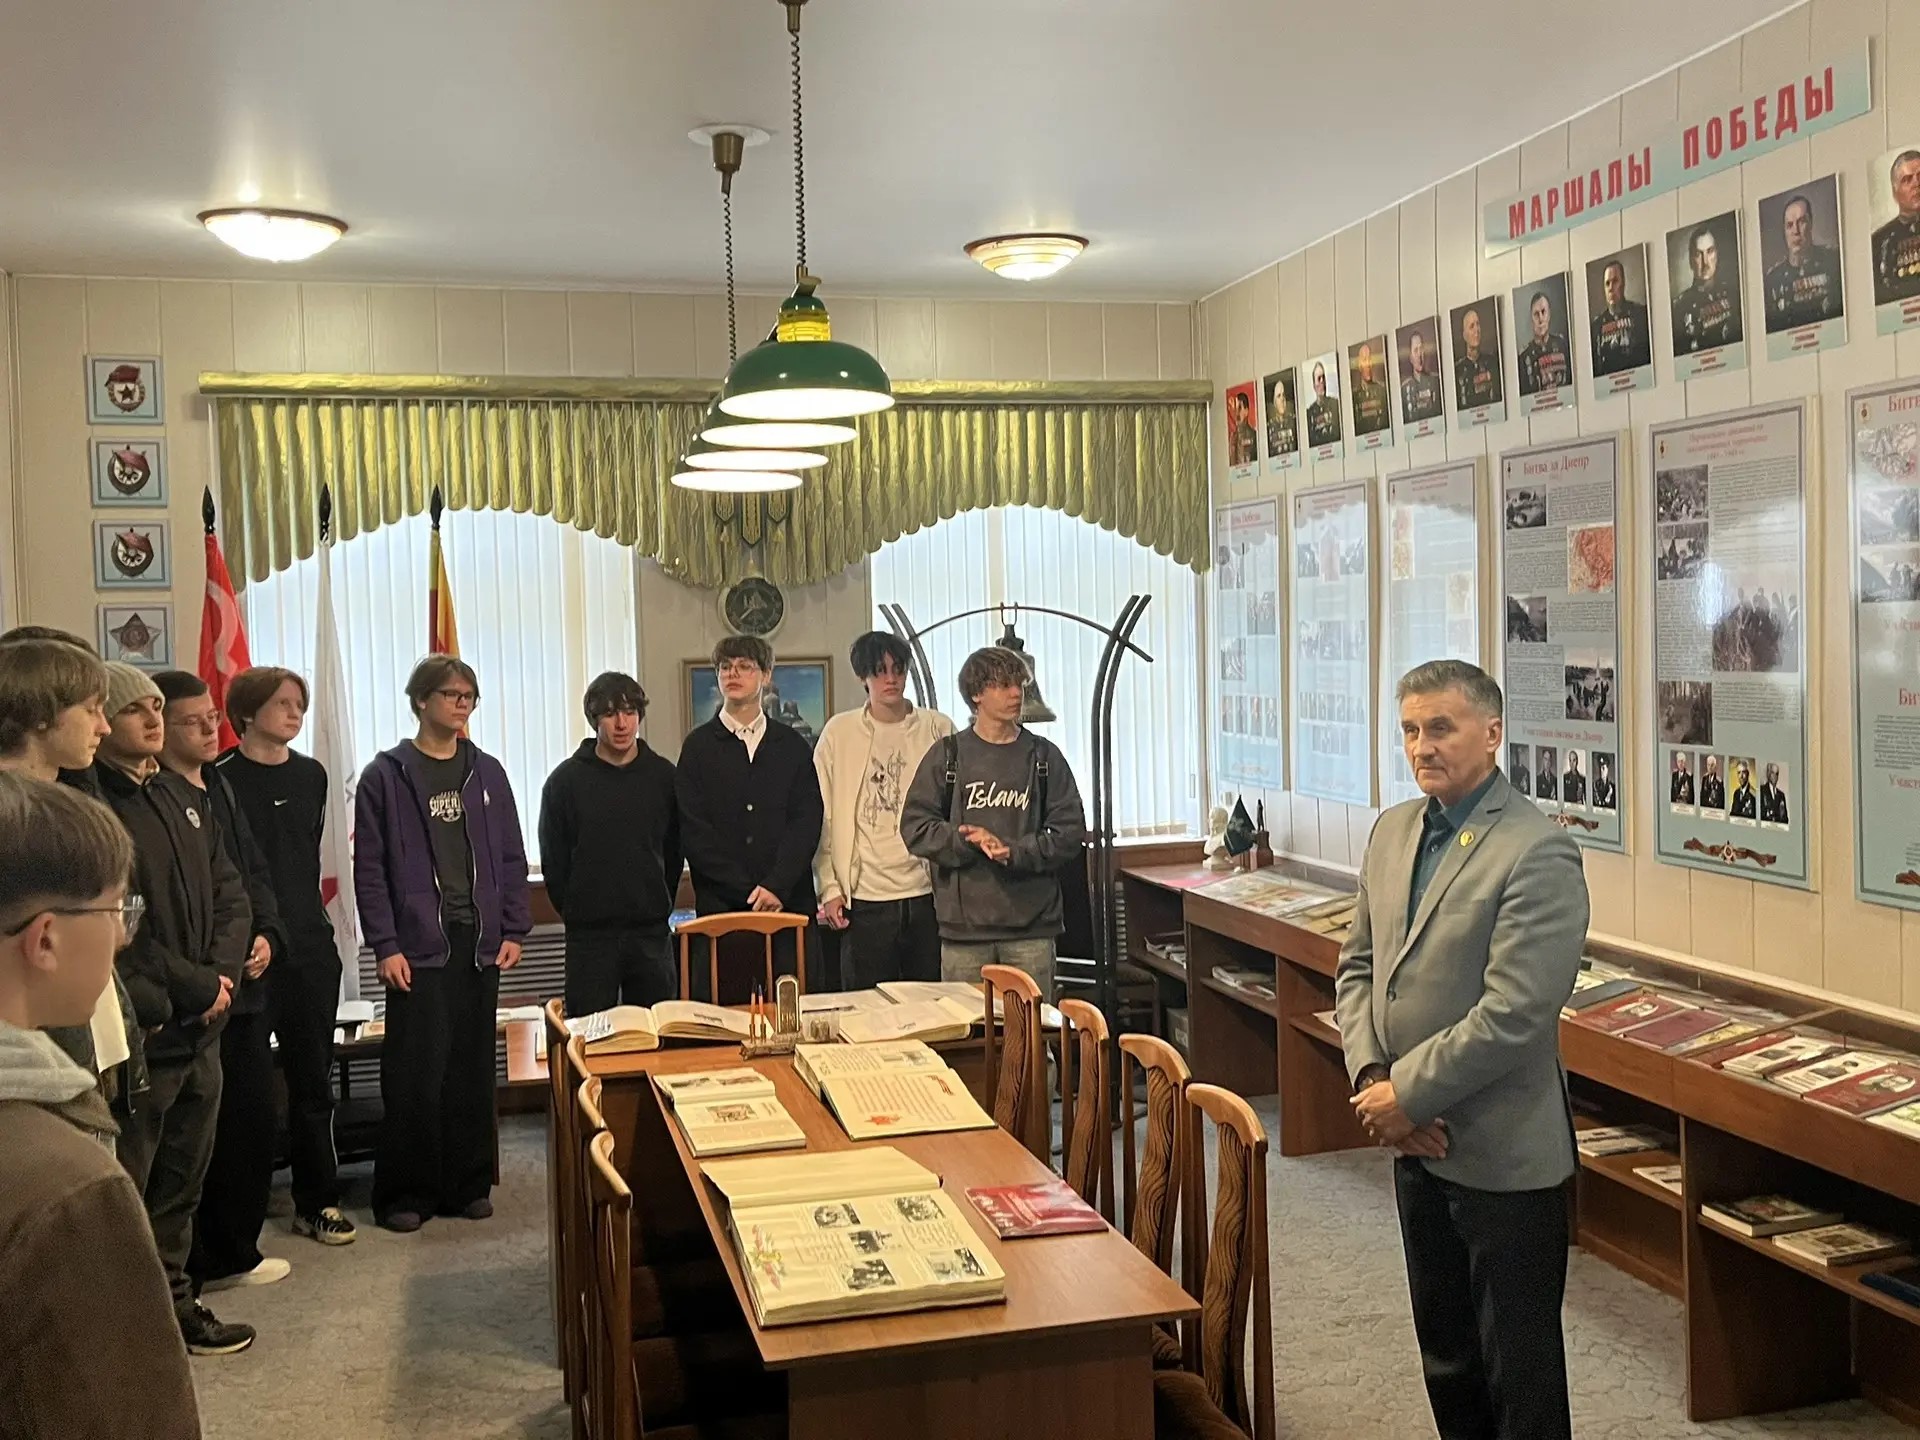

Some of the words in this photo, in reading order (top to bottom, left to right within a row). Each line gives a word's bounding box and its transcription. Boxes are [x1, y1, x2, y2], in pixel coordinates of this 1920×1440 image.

[1508, 146, 1652, 240] МАРШАЛЫ
[1682, 66, 1835, 170] ПОБЕДЫ
[1899, 687, 1920, 706] Би
[965, 781, 1030, 811] Island
